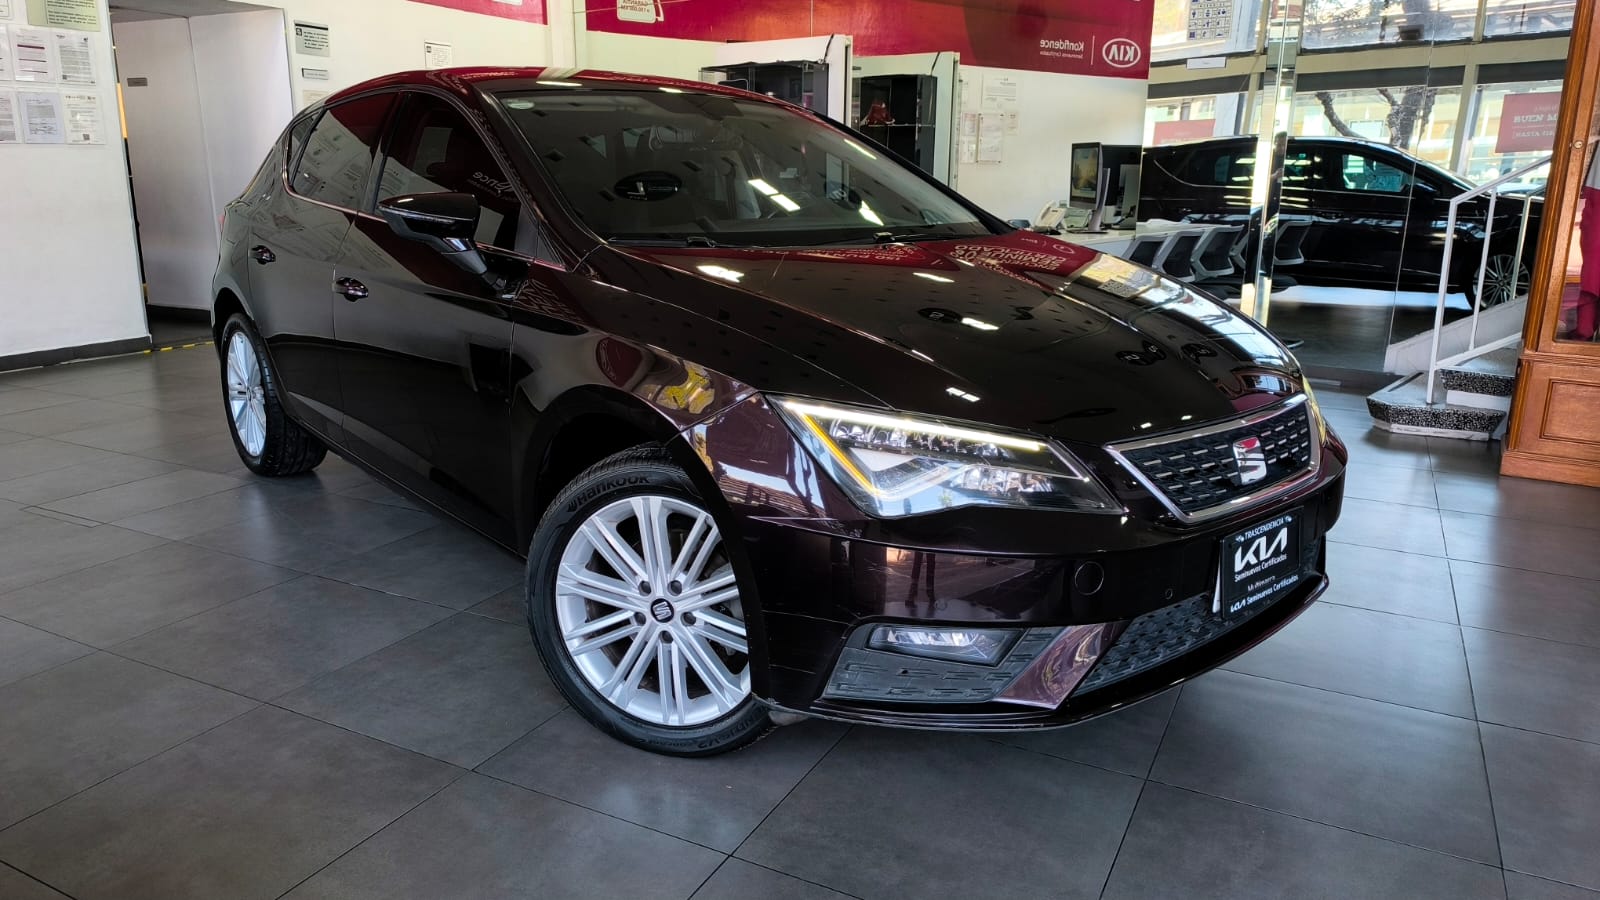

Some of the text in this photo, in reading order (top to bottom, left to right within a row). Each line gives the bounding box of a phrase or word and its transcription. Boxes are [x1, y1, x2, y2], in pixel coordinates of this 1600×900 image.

[1245, 518, 1284, 539] TRASCENDENCIA
[1234, 527, 1288, 572] KIA
[1234, 554, 1287, 582] Seminuevos Certificados
[1246, 588, 1272, 605] Seminuevos
[1273, 574, 1299, 591] Certificados
